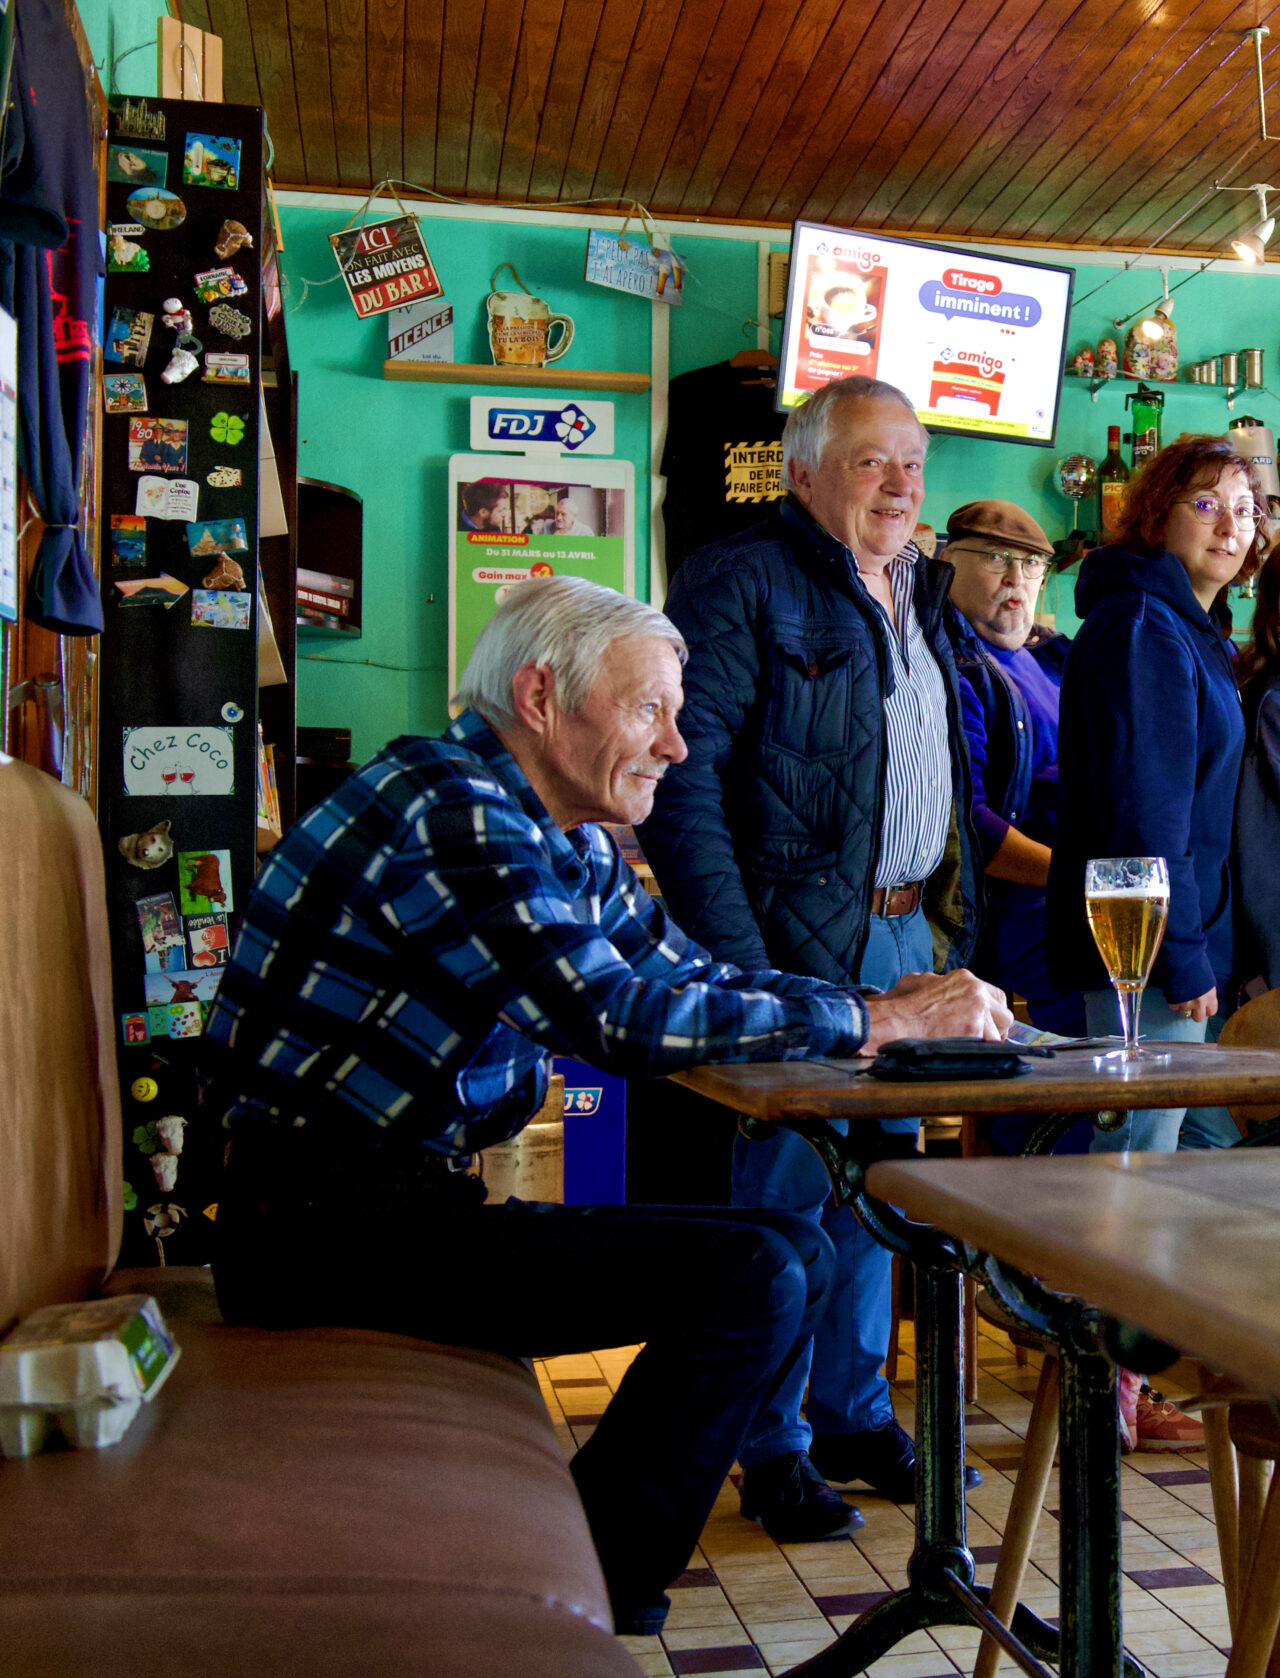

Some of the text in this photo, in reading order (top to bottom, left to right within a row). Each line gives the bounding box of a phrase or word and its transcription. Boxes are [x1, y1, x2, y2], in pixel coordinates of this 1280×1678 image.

[360, 226, 392, 250] ICI
[344, 244, 420, 272] ON FAIT AVEC
[634, 248, 649, 270] PAS
[833, 247, 881, 270] amigo
[200, 270, 228, 282] LORRAINE
[348, 254, 426, 286] LES MOYENS
[358, 288, 384, 314] DU
[385, 272, 425, 303] BAR
[950, 272, 996, 293] Tirage
[934, 290, 1030, 321] imminent !
[390, 309, 450, 360] LICENCE
[957, 351, 1002, 375] amigo
[131, 421, 142, 431] 19
[138, 428, 152, 439] 80
[492, 414, 544, 436] FDJ
[734, 450, 784, 464] INTERD
[750, 470, 763, 480] DE
[734, 481, 783, 494] FAIRE CH
[471, 534, 525, 544] ANIMATION
[486, 548, 499, 556] Du
[501, 549, 510, 557] 31
[512, 549, 540, 558] MARS
[568, 551, 596, 560] AVRIL
[478, 571, 502, 580] Gain
[504, 573, 526, 581] max
[130, 733, 228, 770] Chez Coco
